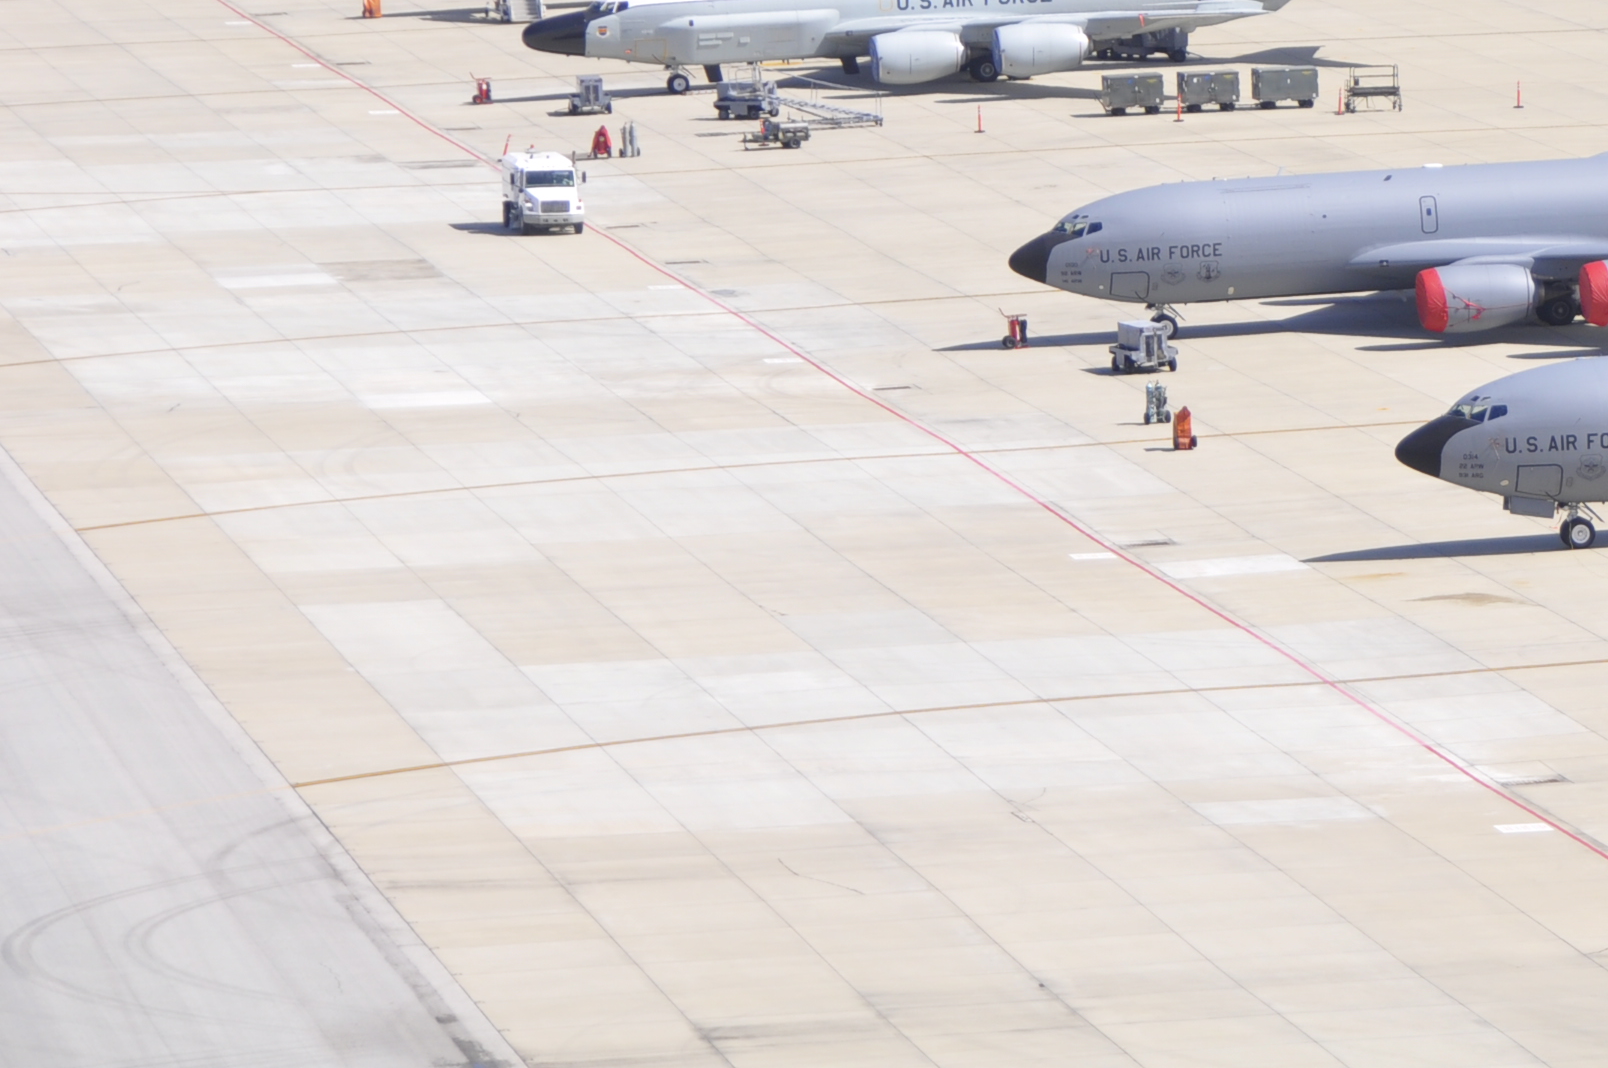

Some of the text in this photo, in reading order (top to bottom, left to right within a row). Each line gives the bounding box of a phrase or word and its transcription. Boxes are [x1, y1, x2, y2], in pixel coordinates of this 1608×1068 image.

[1136, 246, 1161, 262] AIR
[1168, 243, 1223, 260] FORCE
[1548, 434, 1578, 452] AIR
